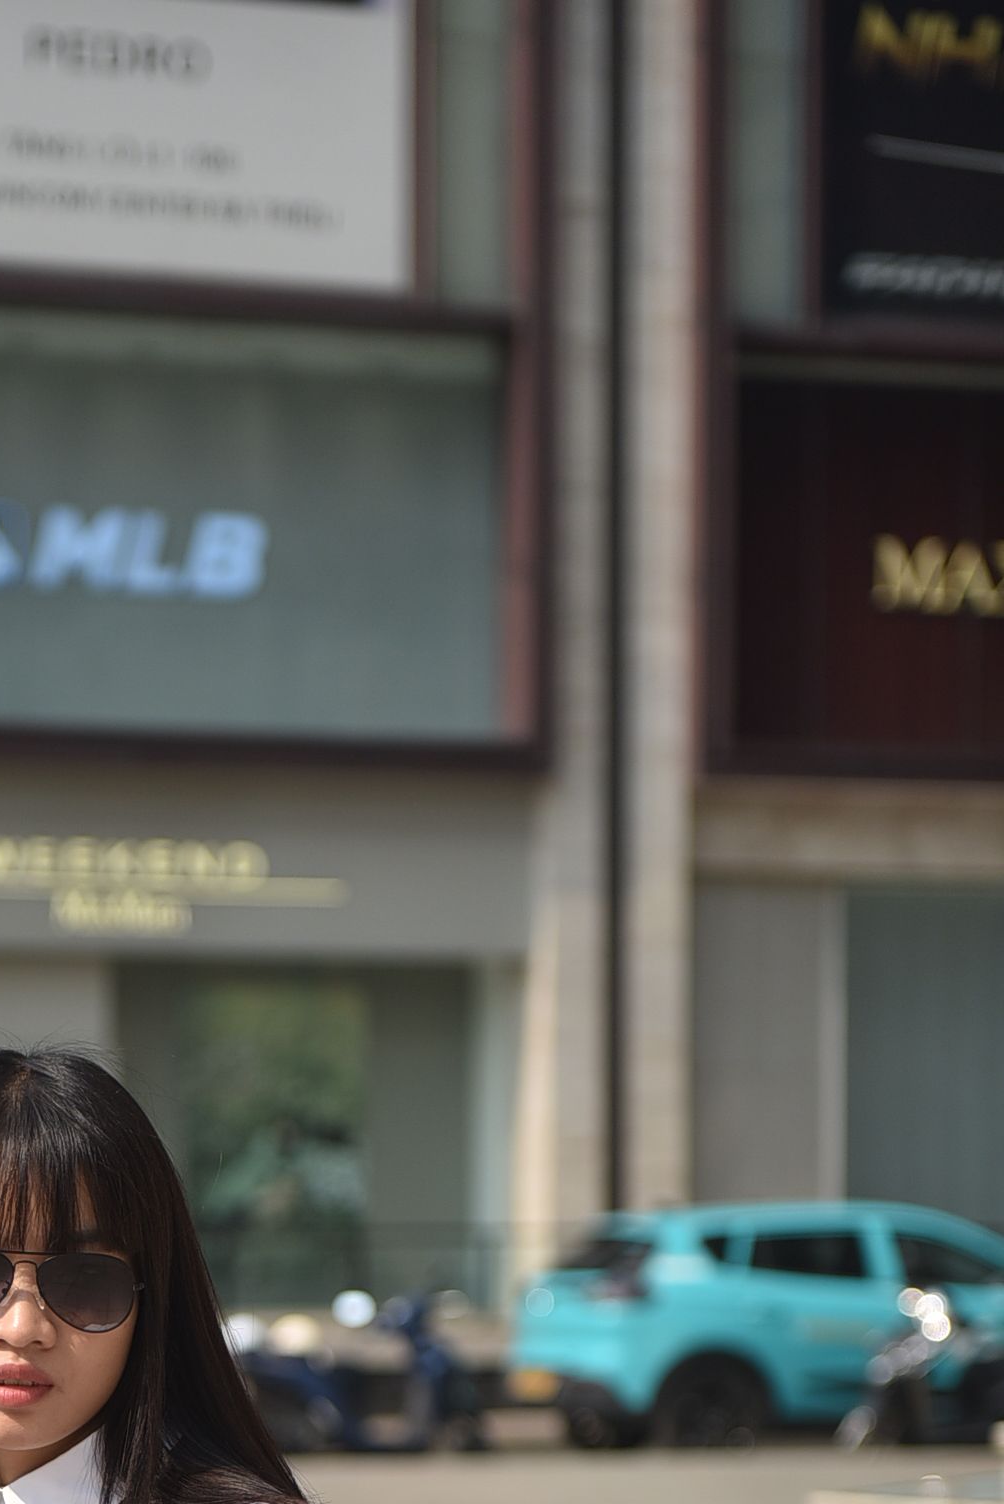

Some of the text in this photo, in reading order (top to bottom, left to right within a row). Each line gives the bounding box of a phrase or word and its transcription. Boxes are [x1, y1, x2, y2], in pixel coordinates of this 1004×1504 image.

[24, 25, 211, 84] PEDRO
[28, 504, 266, 599] MLB
[870, 532, 1004, 618] MA
